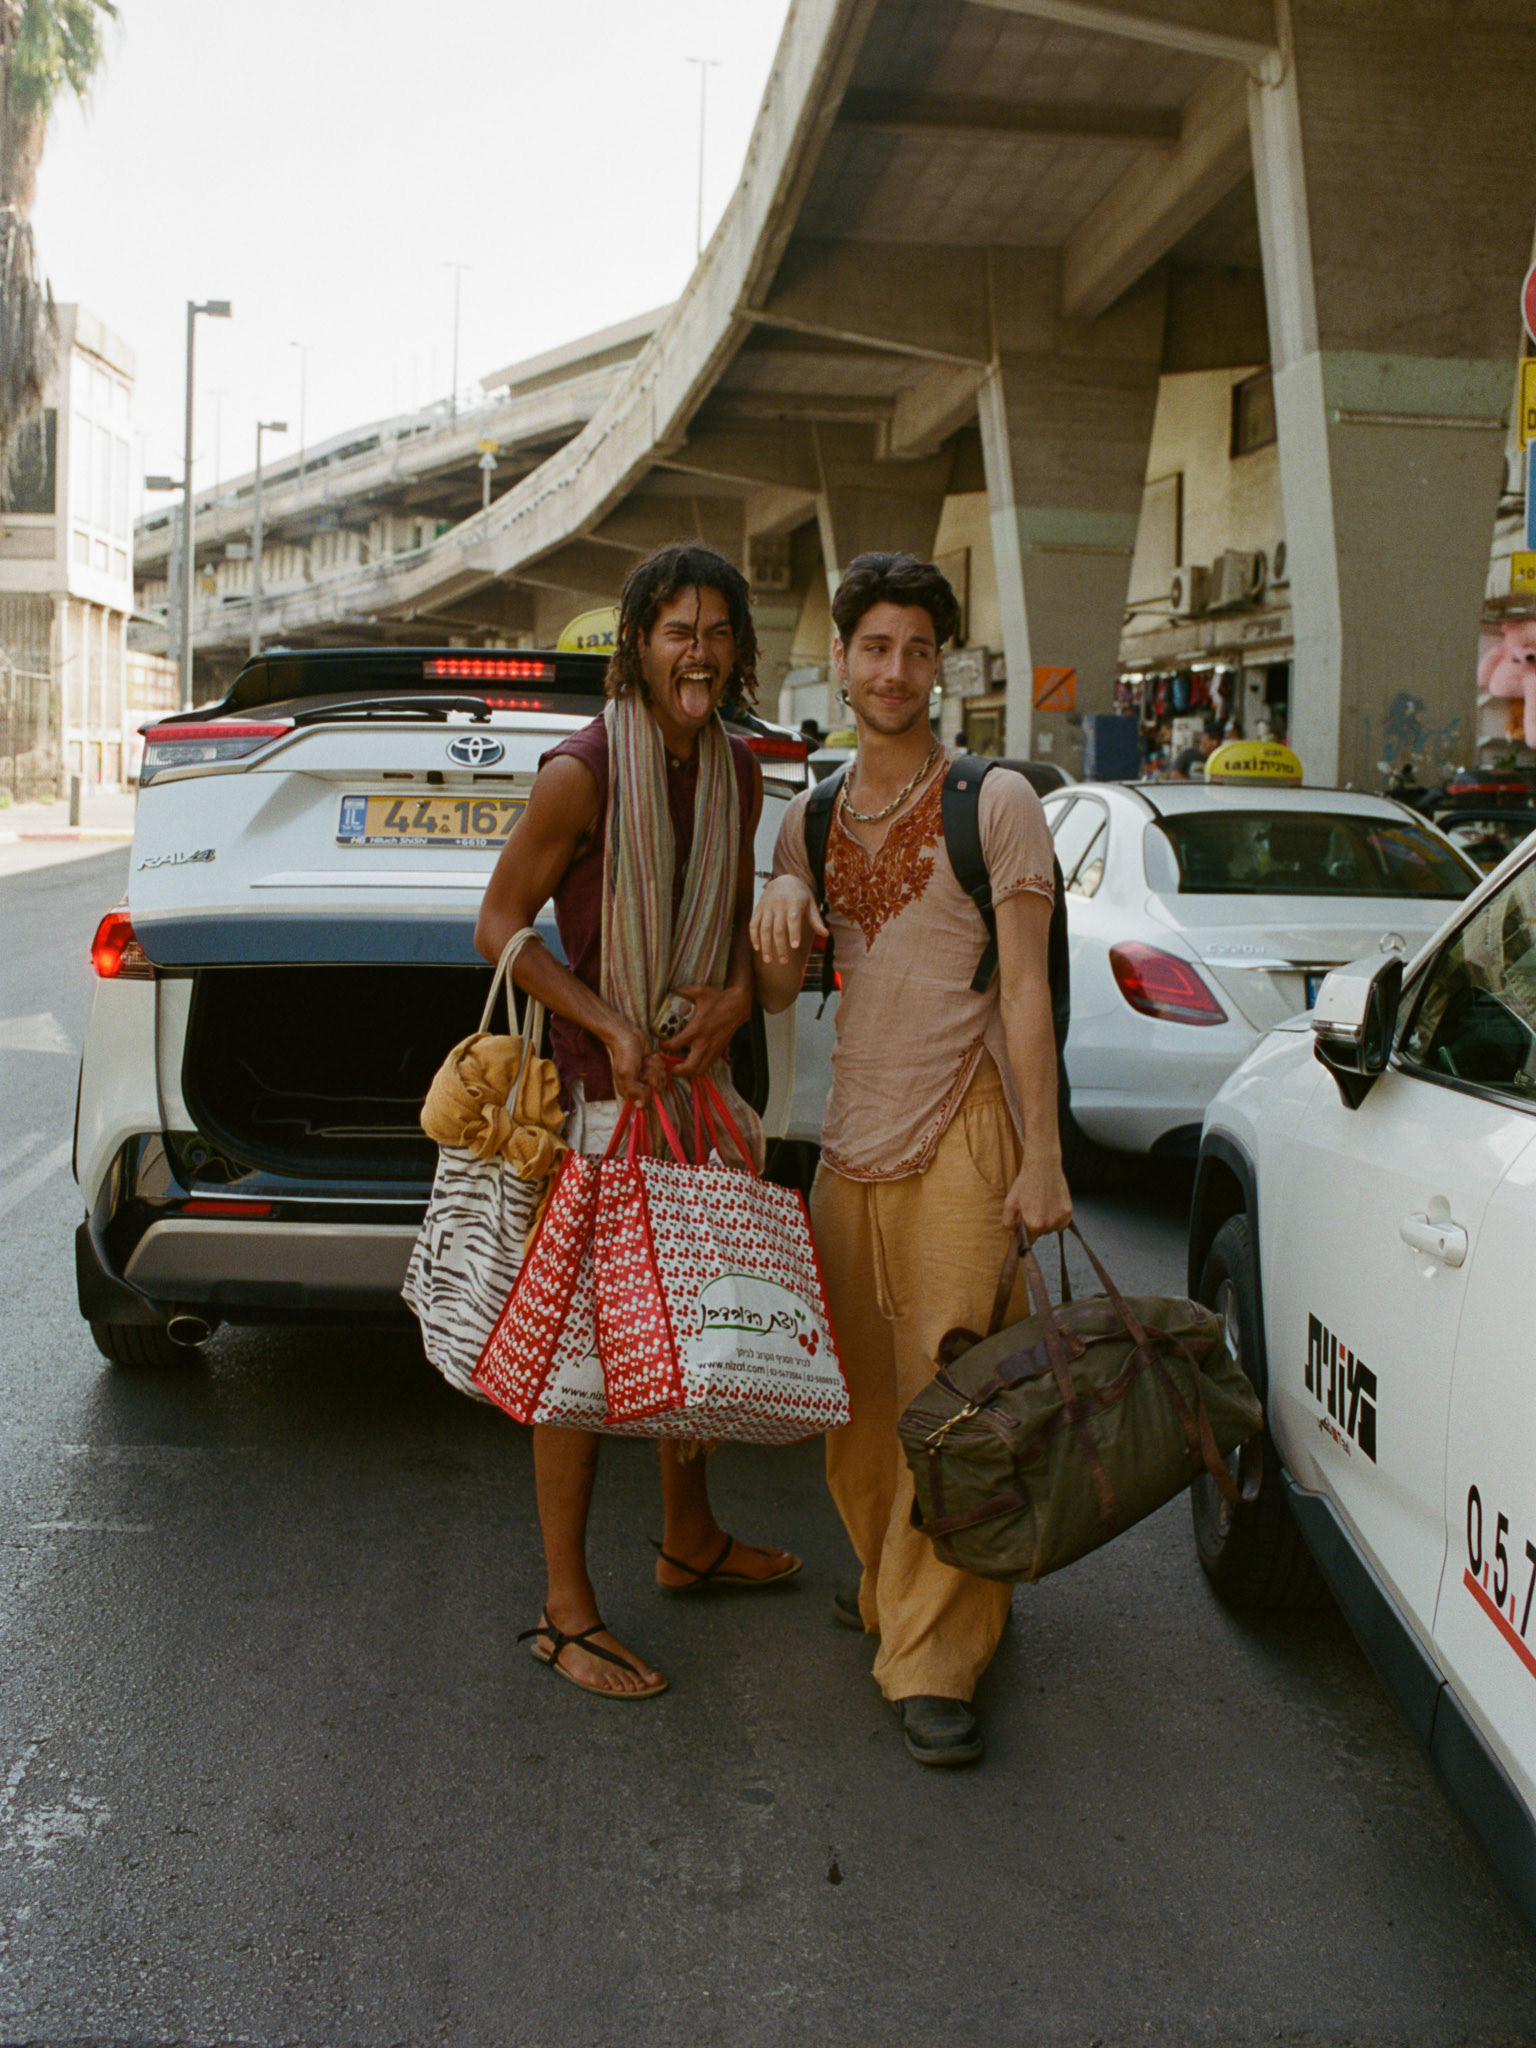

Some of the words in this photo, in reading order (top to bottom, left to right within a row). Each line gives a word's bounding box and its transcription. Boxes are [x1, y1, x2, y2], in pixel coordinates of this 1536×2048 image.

[577, 631, 615, 650] tax
[1224, 756, 1257, 771] taxi
[344, 808, 360, 826] IL
[136, 848, 216, 872] RAV4
[696, 1360, 766, 1375] www.nizat.com
